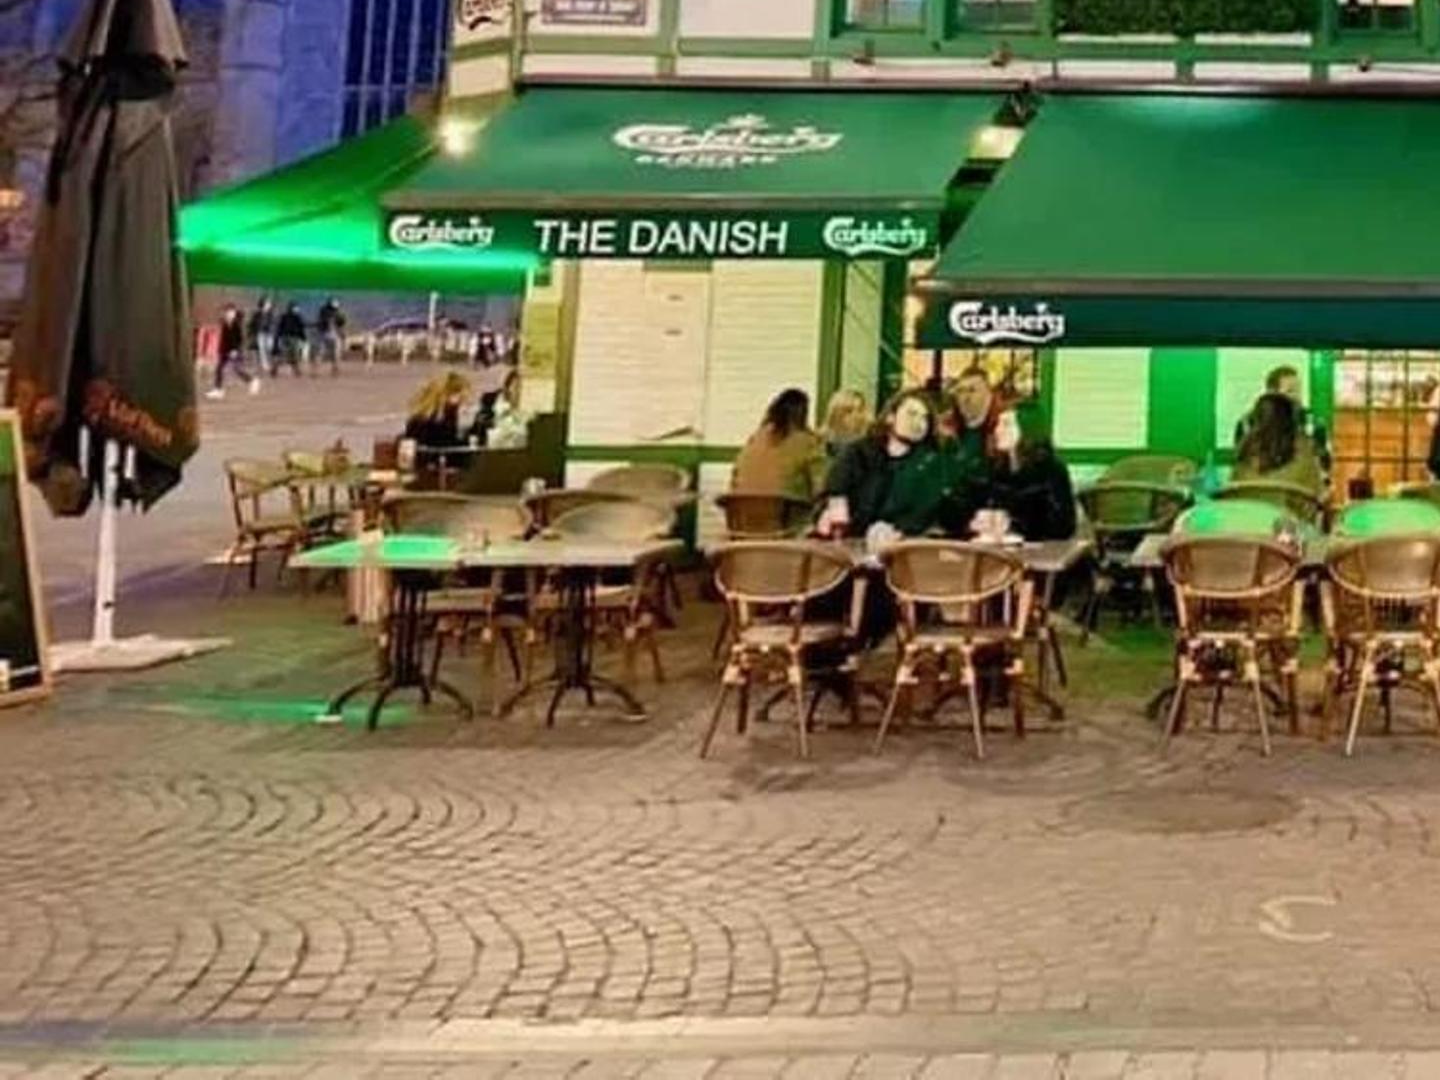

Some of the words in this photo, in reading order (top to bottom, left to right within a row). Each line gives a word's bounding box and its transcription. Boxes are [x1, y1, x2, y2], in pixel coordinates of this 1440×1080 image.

[389, 215, 494, 248] Carlsberg
[534, 220, 617, 253] THE
[628, 220, 789, 254] DANISH
[823, 216, 927, 256] Carlsberg
[949, 301, 1065, 344] Carlsberg
